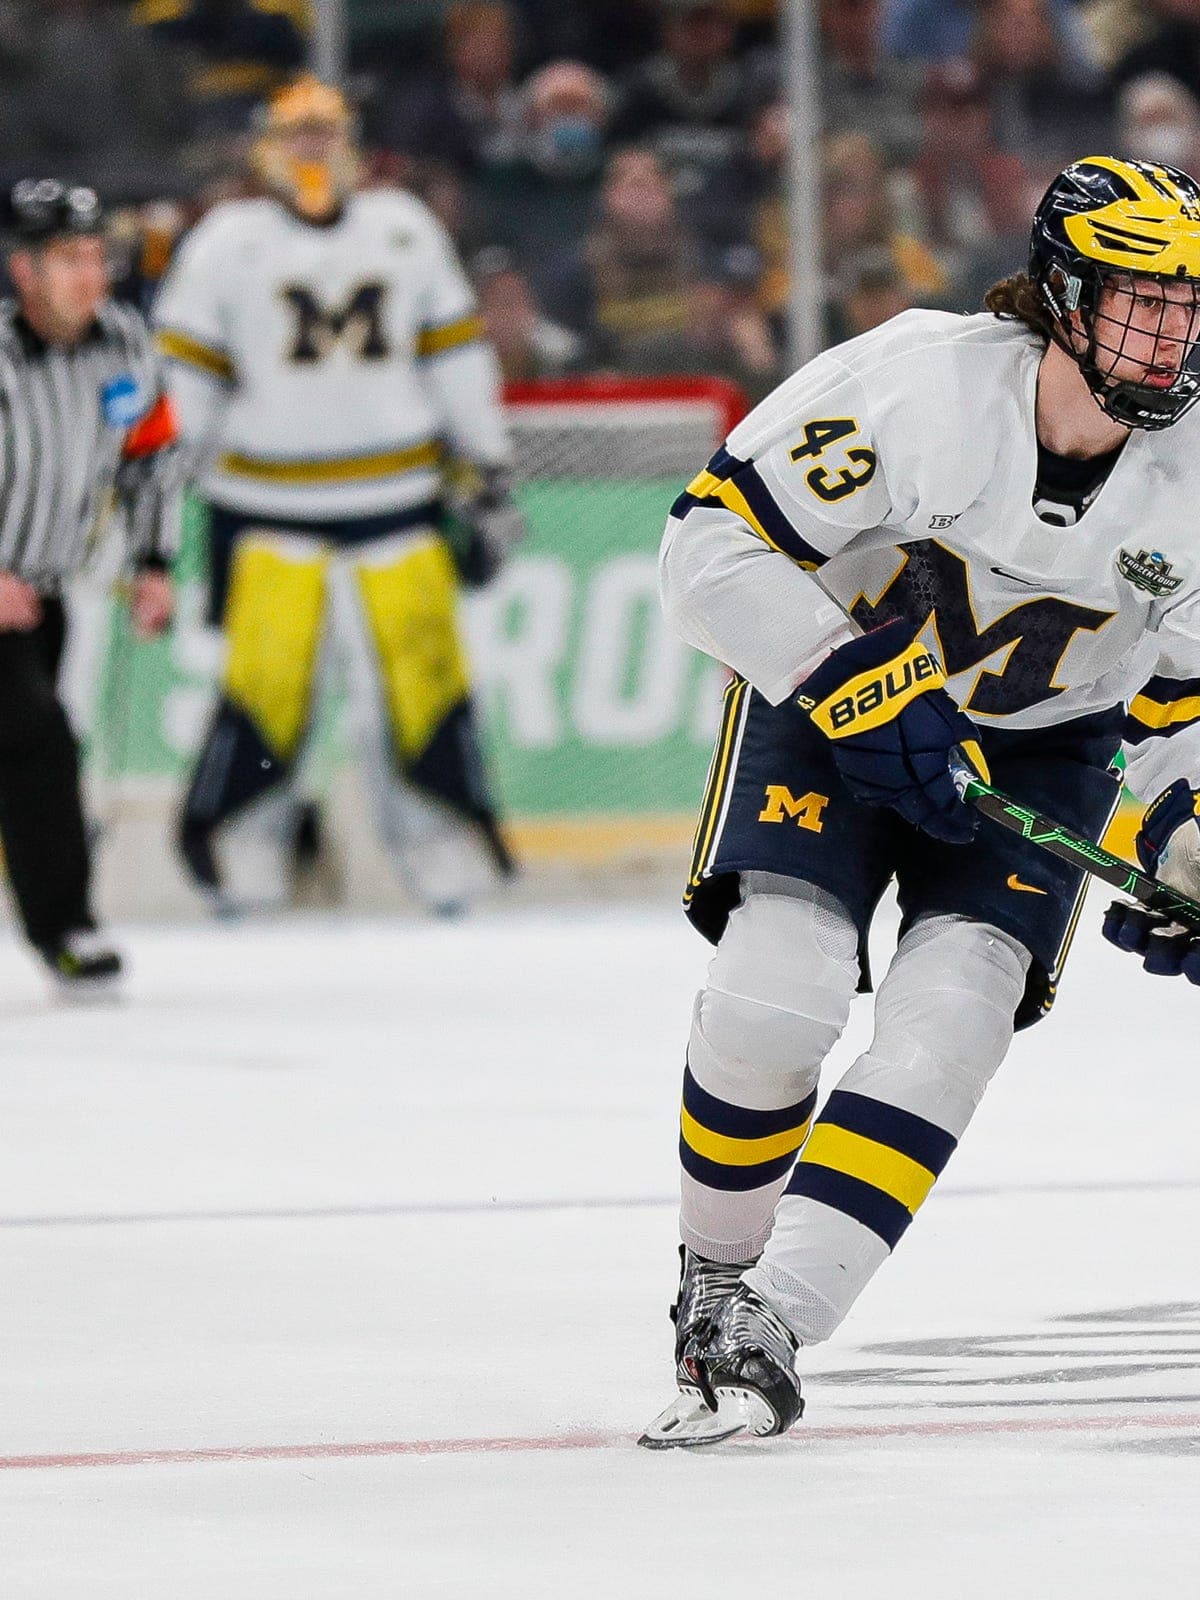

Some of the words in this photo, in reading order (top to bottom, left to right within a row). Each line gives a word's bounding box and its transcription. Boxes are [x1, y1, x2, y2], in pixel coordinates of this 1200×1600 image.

[279, 278, 389, 361] M
[788, 416, 877, 505] 43
[846, 537, 1119, 717] M
[758, 784, 829, 834] M
